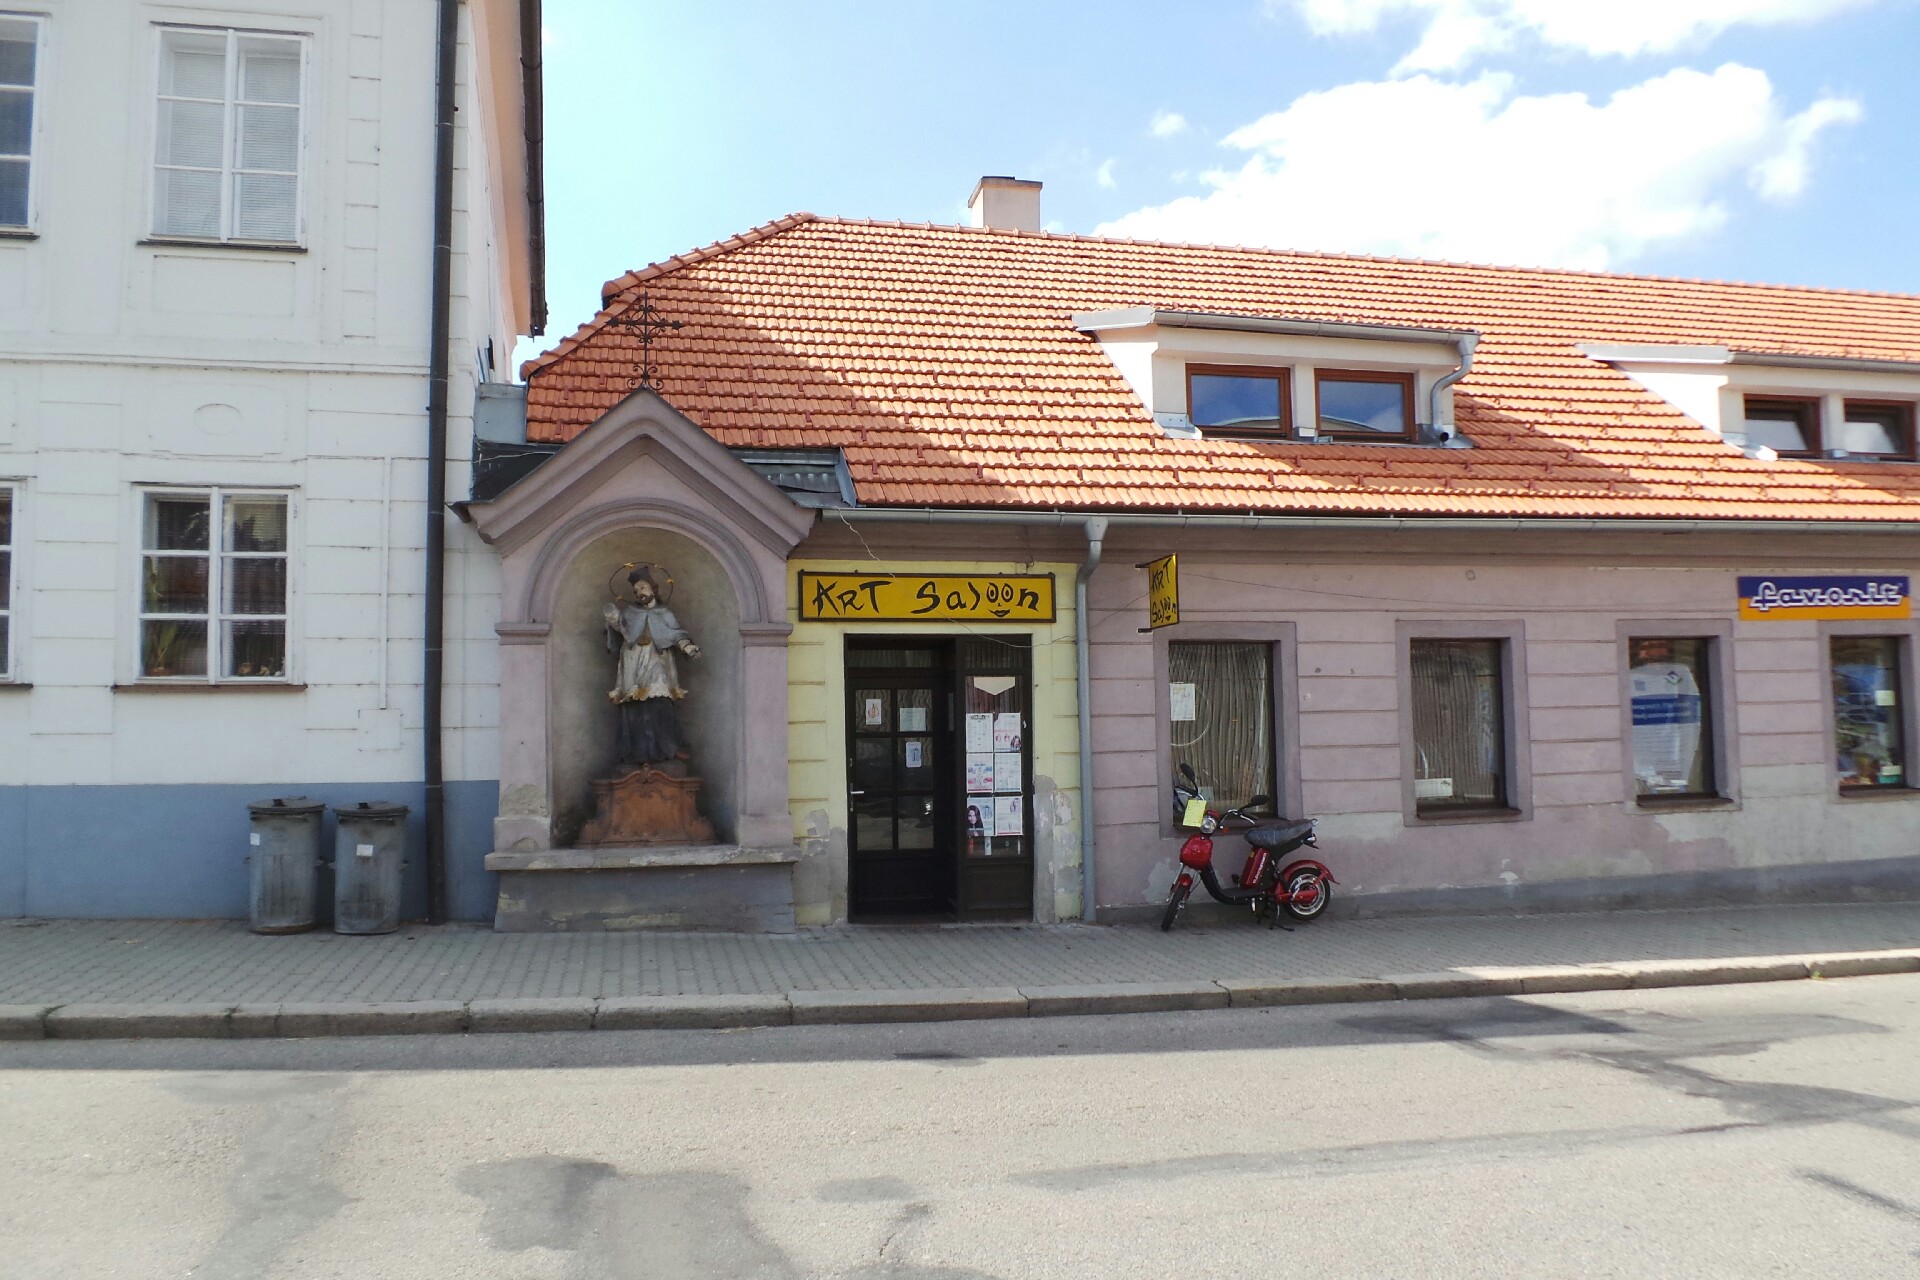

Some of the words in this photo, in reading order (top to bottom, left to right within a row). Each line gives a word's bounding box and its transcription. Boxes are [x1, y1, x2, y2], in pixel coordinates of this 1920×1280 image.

[1151, 557, 1172, 593] ART
[812, 578, 892, 617] ART
[910, 580, 1040, 615] Saloon
[1749, 581, 1903, 611] favorit
